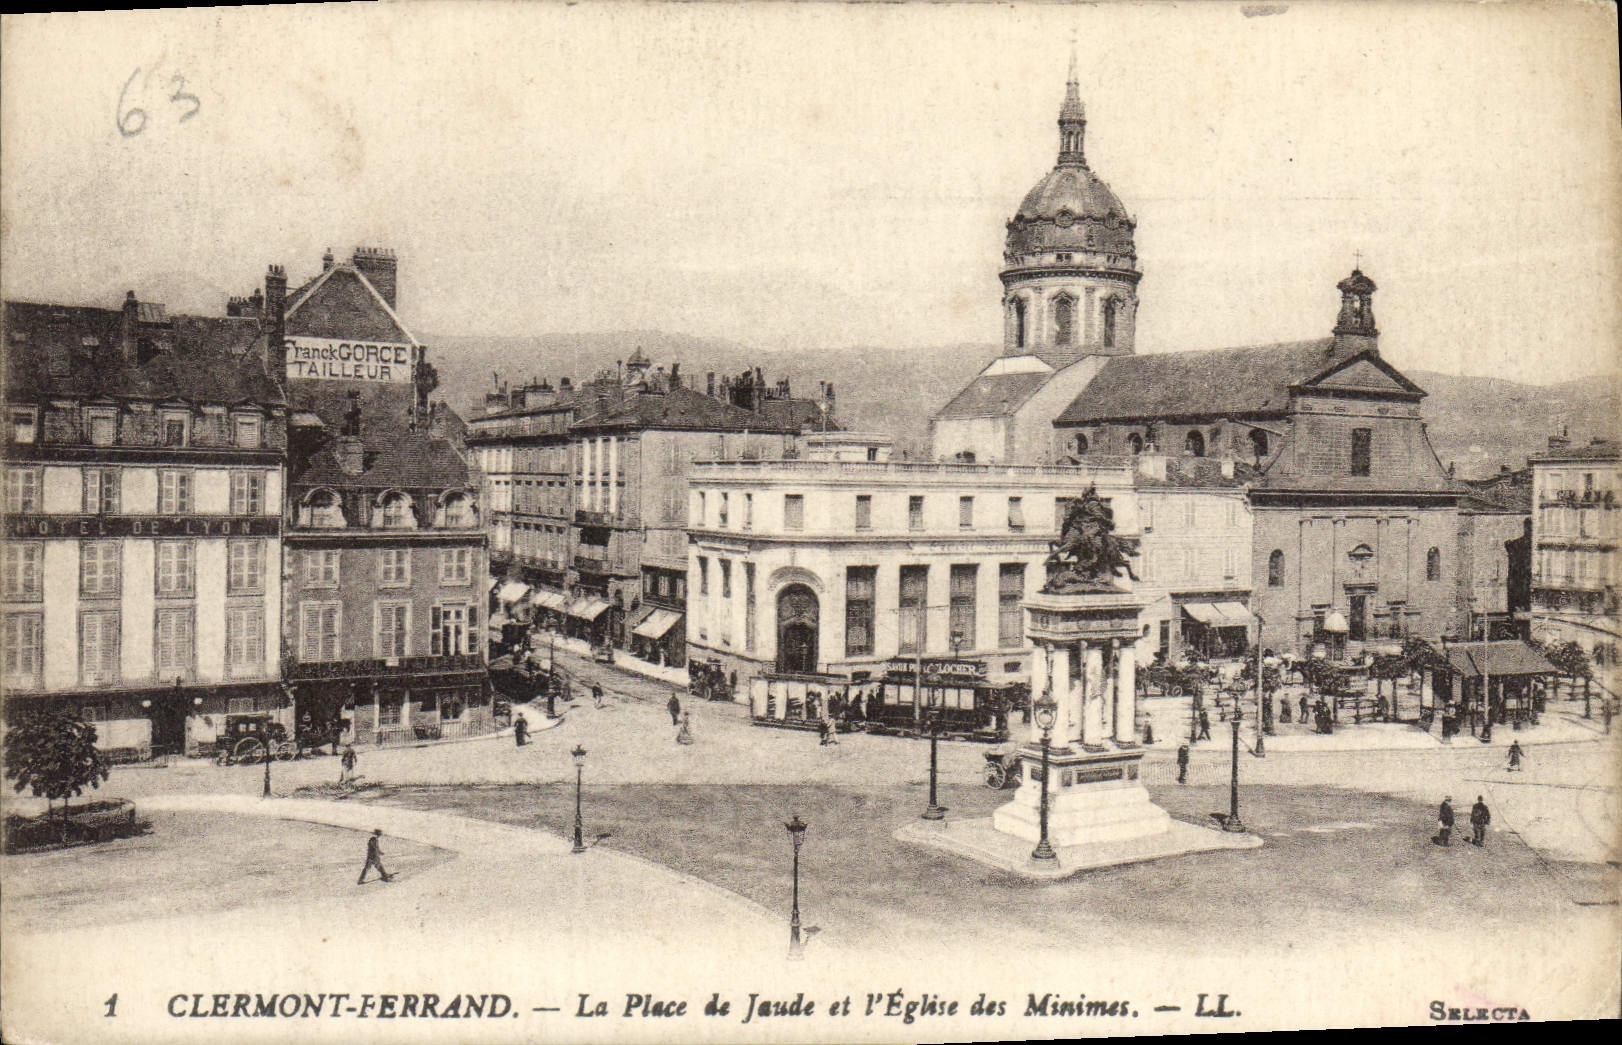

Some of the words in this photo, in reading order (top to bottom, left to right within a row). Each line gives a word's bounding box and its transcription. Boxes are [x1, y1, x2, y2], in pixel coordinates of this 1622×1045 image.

[116, 66, 201, 137] 63
[338, 343, 407, 364] GORCE
[292, 361, 391, 380] TAILLEUR
[133, 521, 160, 535] DE
[186, 520, 251, 535] LYON
